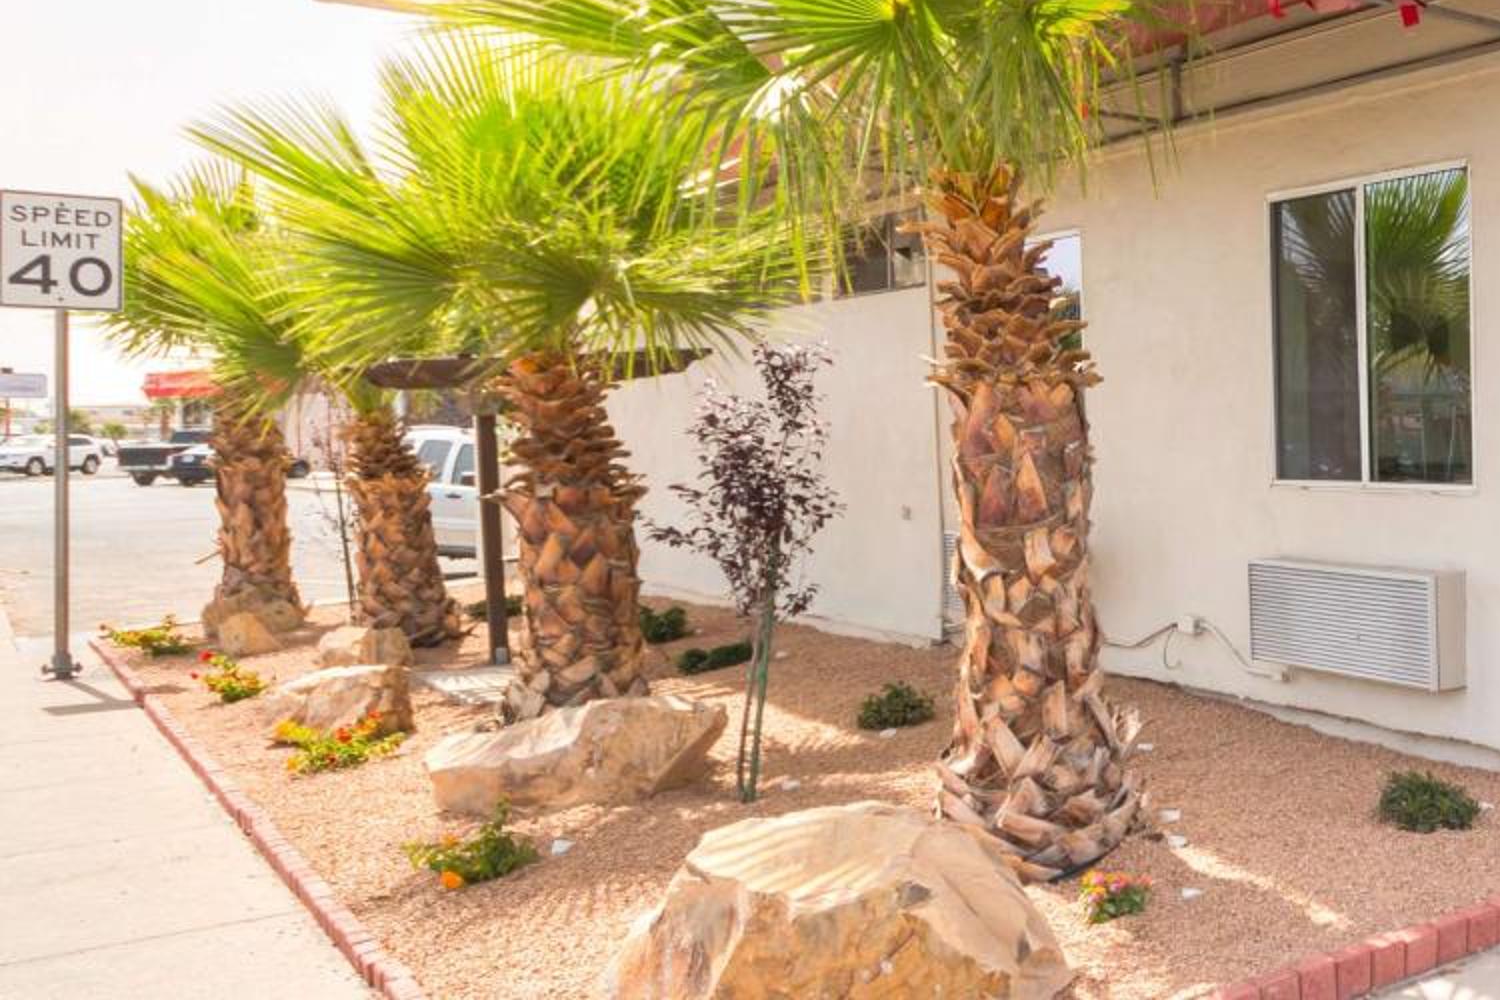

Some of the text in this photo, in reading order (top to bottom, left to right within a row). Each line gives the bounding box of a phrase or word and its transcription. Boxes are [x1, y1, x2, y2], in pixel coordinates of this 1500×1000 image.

[9, 205, 112, 227] SPEED
[21, 229, 99, 250] LIMIT
[8, 254, 112, 296] 40
